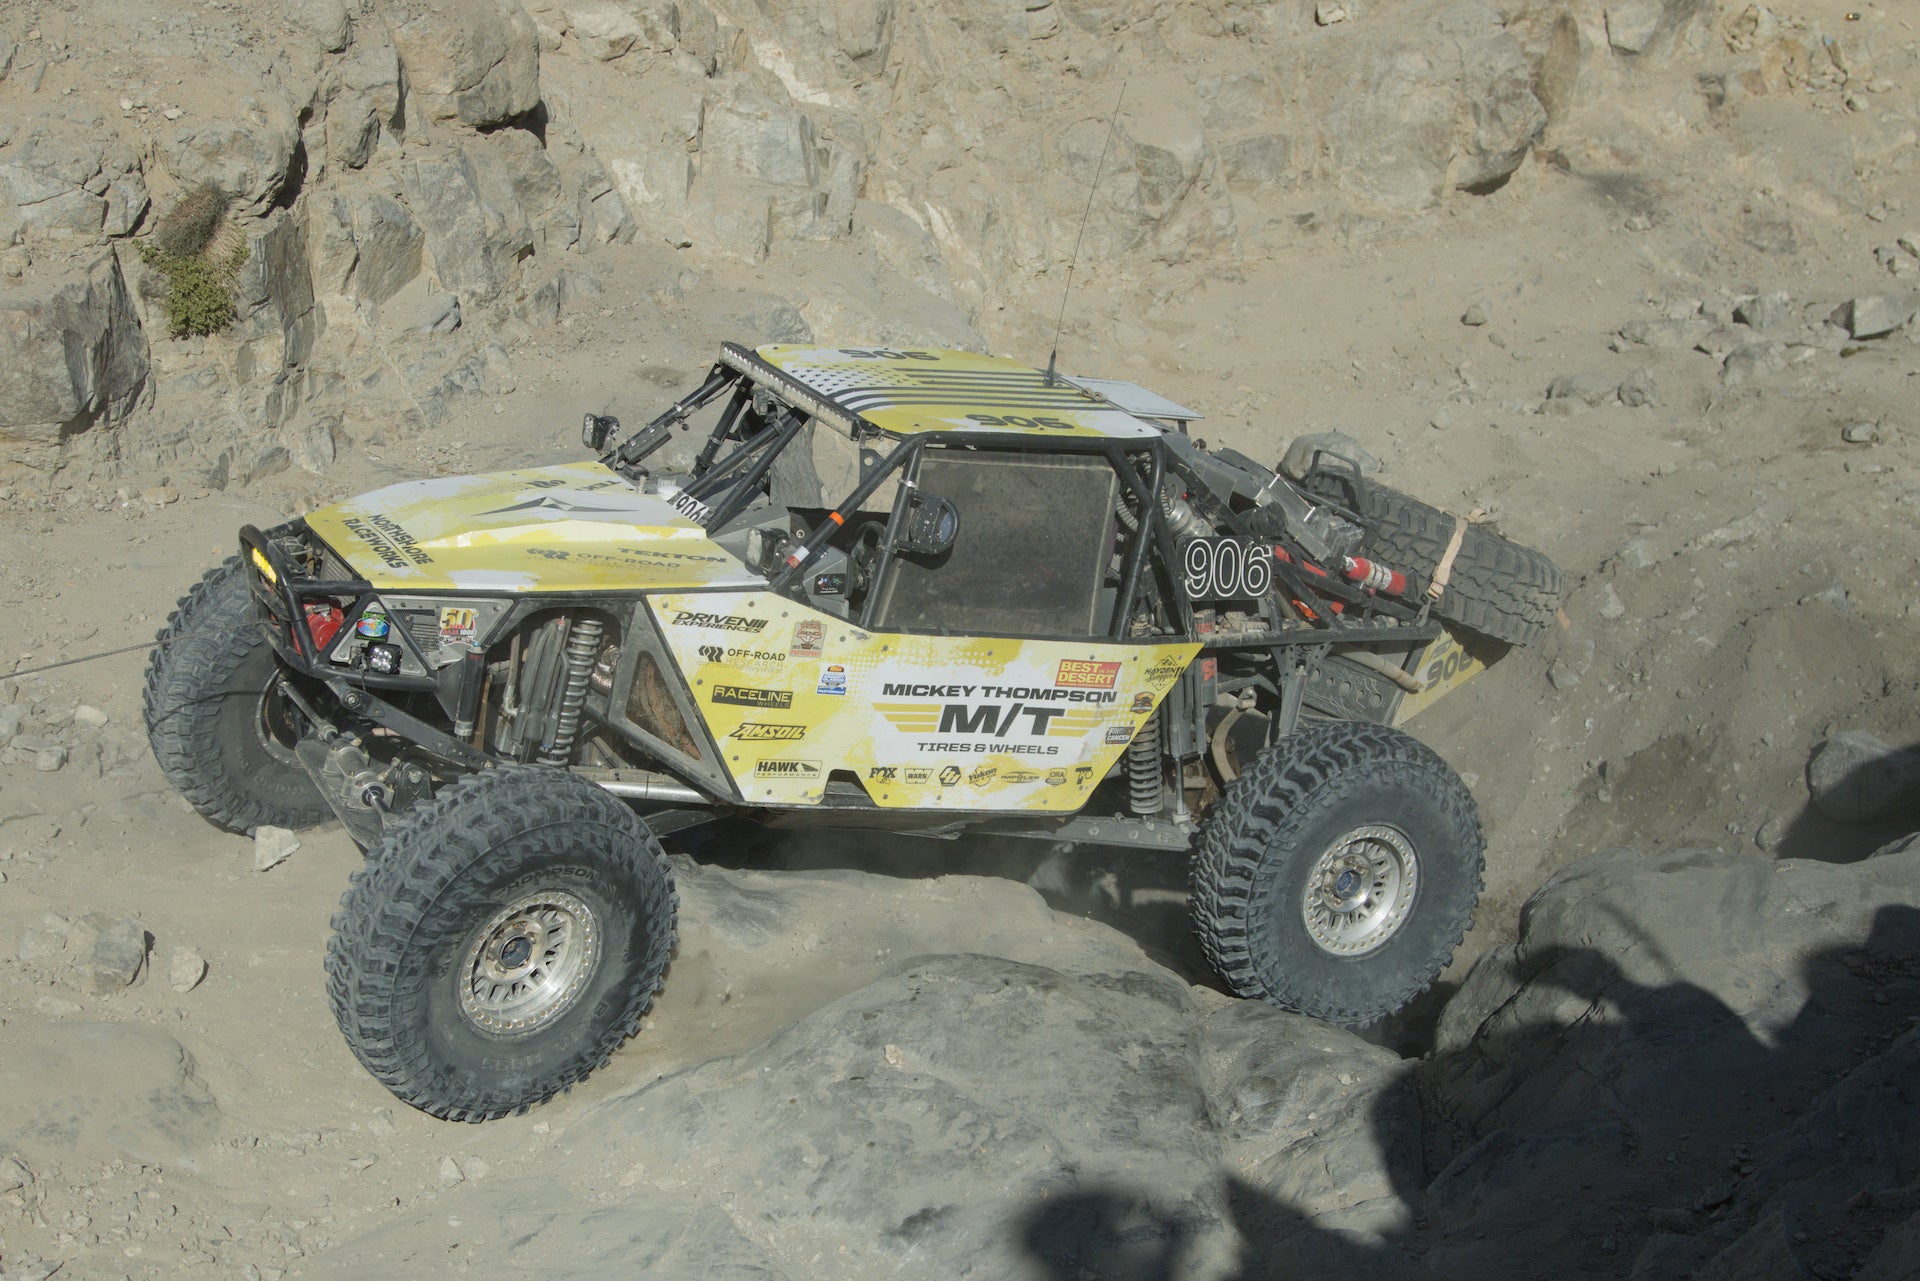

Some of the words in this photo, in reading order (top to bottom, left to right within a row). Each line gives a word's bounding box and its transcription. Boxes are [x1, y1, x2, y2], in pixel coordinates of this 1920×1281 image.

[838, 349, 941, 361] 906
[965, 414, 1075, 429] 906
[342, 518, 409, 569] RACEWORKS
[367, 514, 435, 565] NORTHSHORE
[577, 553, 681, 568] OFF-ROAD
[616, 547, 728, 563] TEKTON
[1185, 538, 1273, 598] 906
[674, 611, 755, 627] DRIVEN
[671, 620, 762, 633] EXPERIENCES
[727, 648, 786, 661] OFF-ROAD
[725, 657, 784, 669] RESEARCH
[1060, 661, 1103, 673] BEST
[1057, 671, 1116, 685] DESERT
[713, 686, 792, 703] RACELINE
[882, 683, 977, 698] MICKEY
[980, 685, 1118, 703] THOMPSON
[757, 700, 790, 708] WHEELS
[938, 703, 1066, 738] M/T
[729, 722, 807, 741] AMSOIL
[916, 742, 972, 752] TIRES
[973, 743, 987, 753] &
[988, 744, 1059, 755] WHEELS
[757, 761, 799, 772] HAWK
[869, 767, 897, 779] FOX
[968, 768, 997, 781] Yukon
